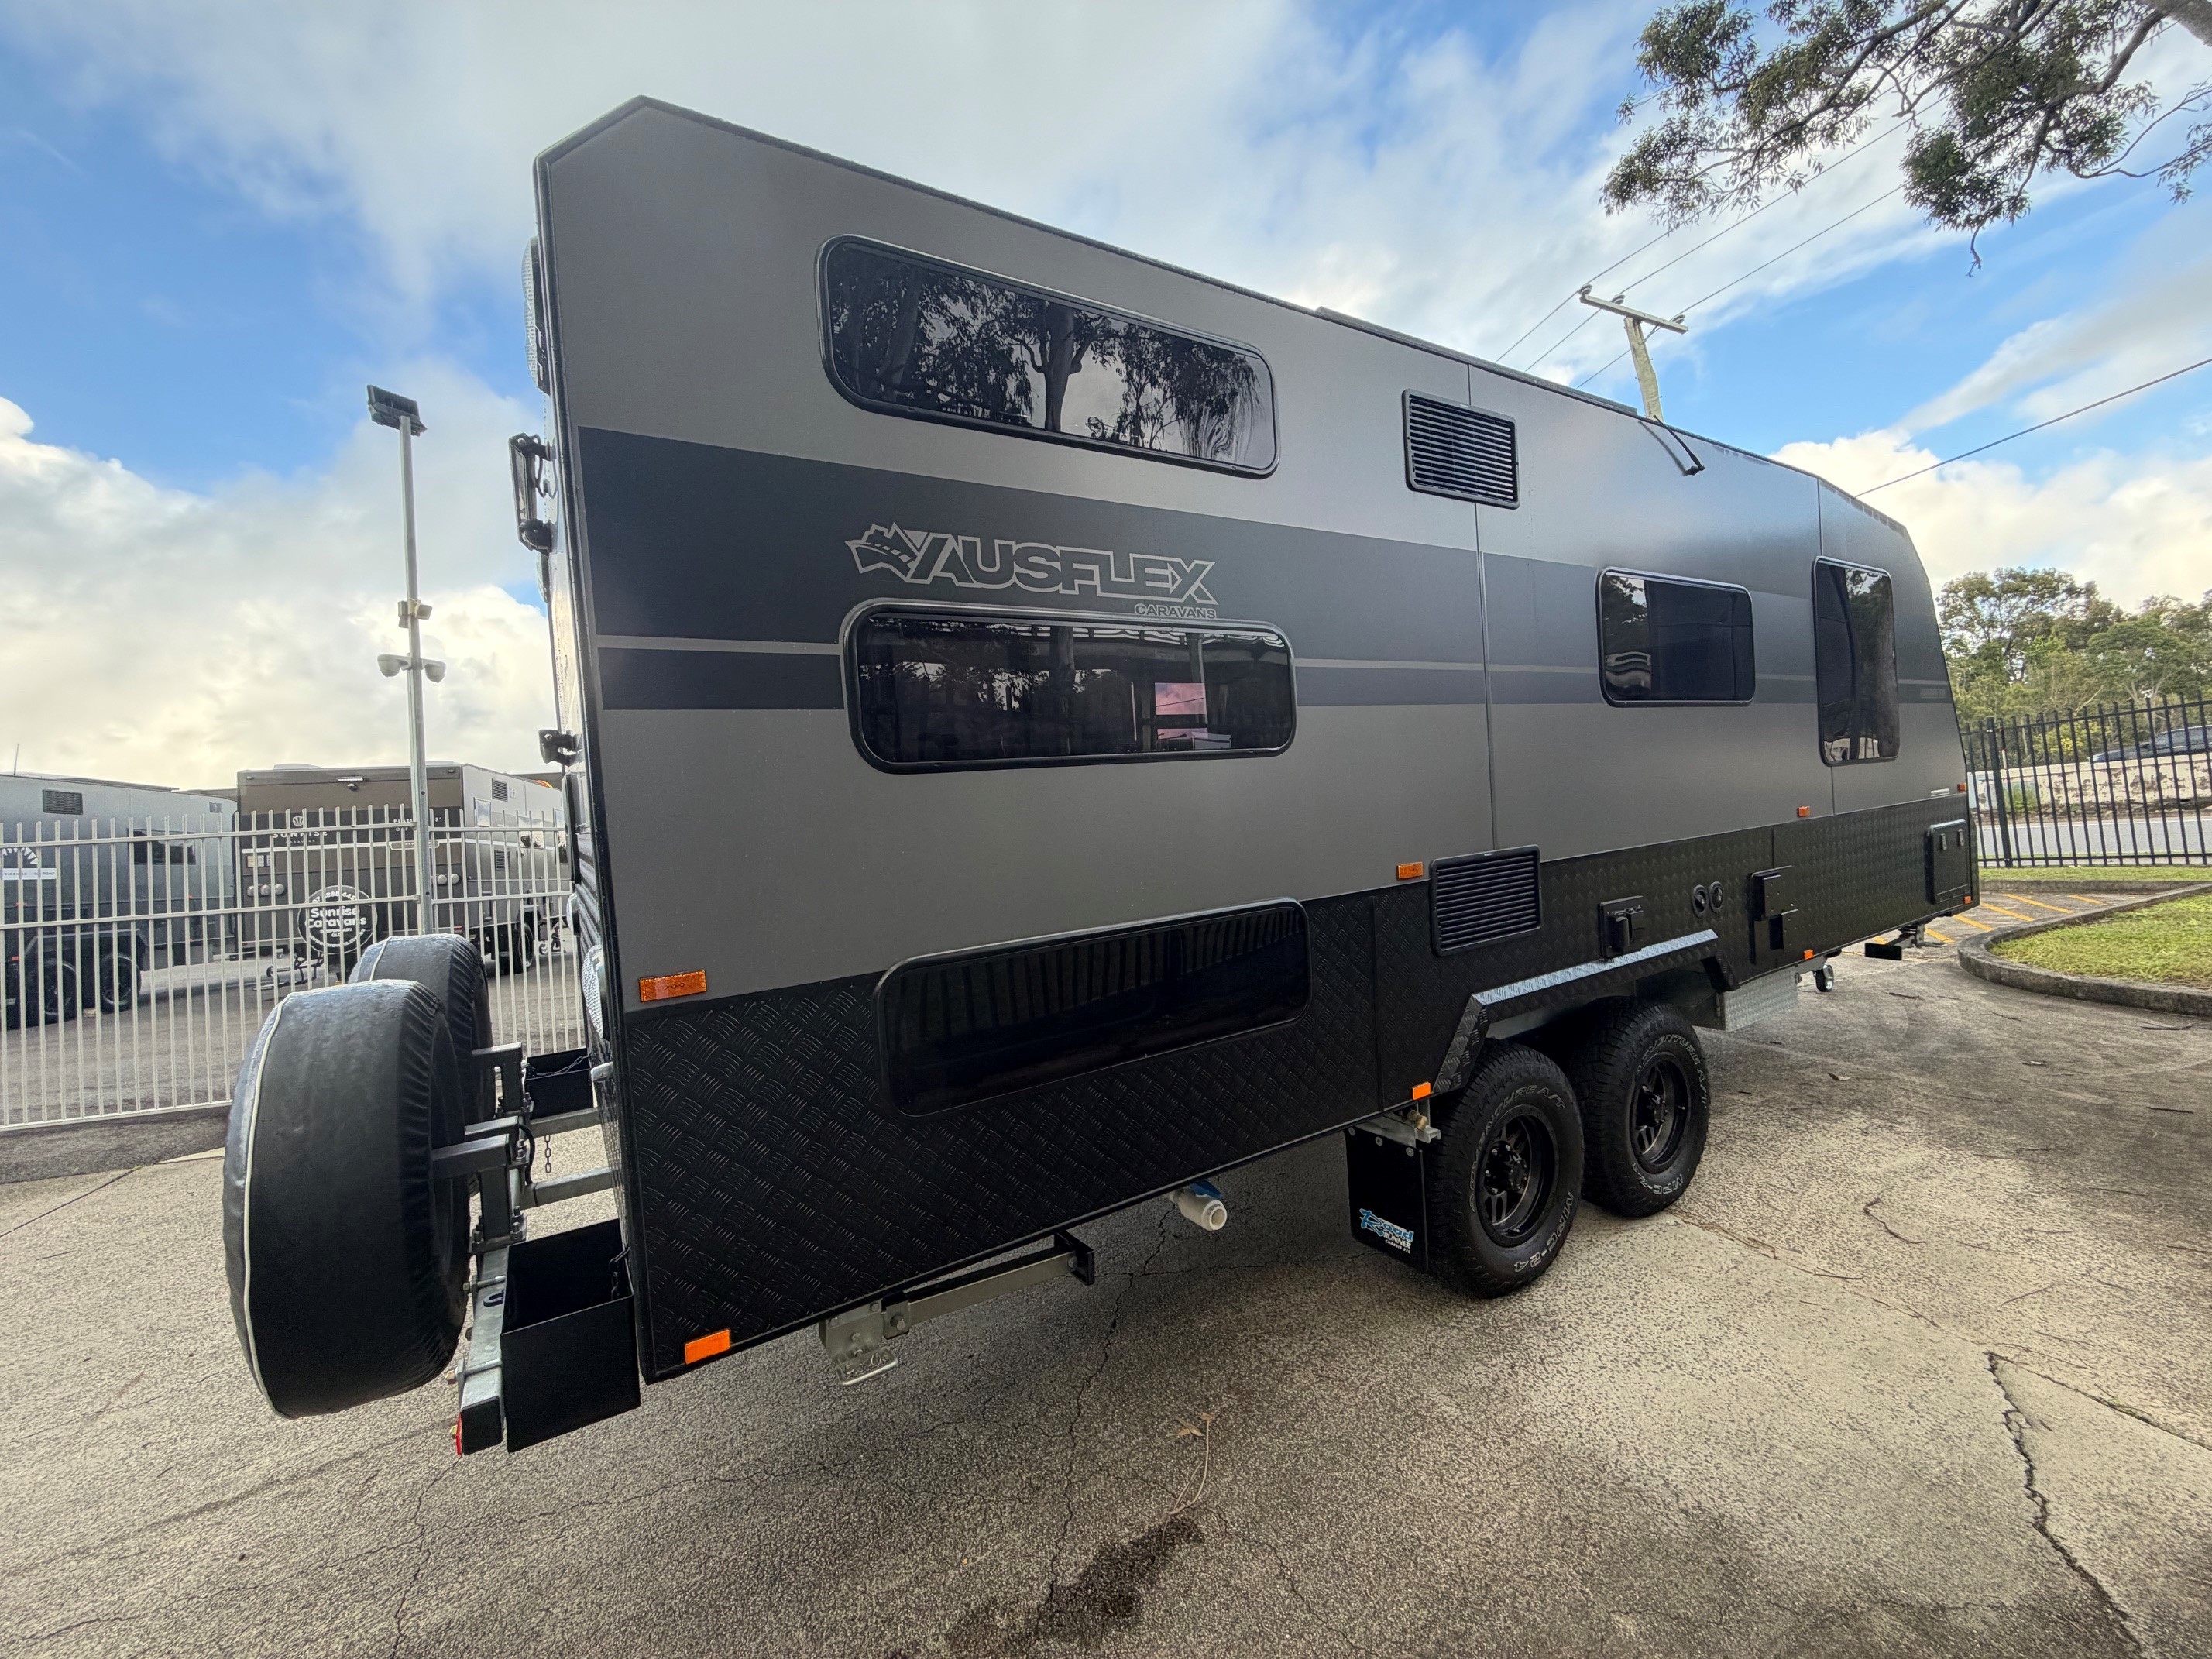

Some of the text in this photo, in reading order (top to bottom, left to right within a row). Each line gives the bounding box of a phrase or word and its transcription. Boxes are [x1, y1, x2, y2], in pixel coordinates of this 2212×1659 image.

[906, 532, 1219, 605] AUSFLEX
[1134, 603, 1217, 619] CARAVANS
[311, 905, 357, 918] Sunrise
[305, 917, 367, 929] Caravans
[1536, 1087, 1566, 1108] A/T
[1359, 1208, 1414, 1242] Road
[1383, 1232, 1411, 1250] RUNNER
